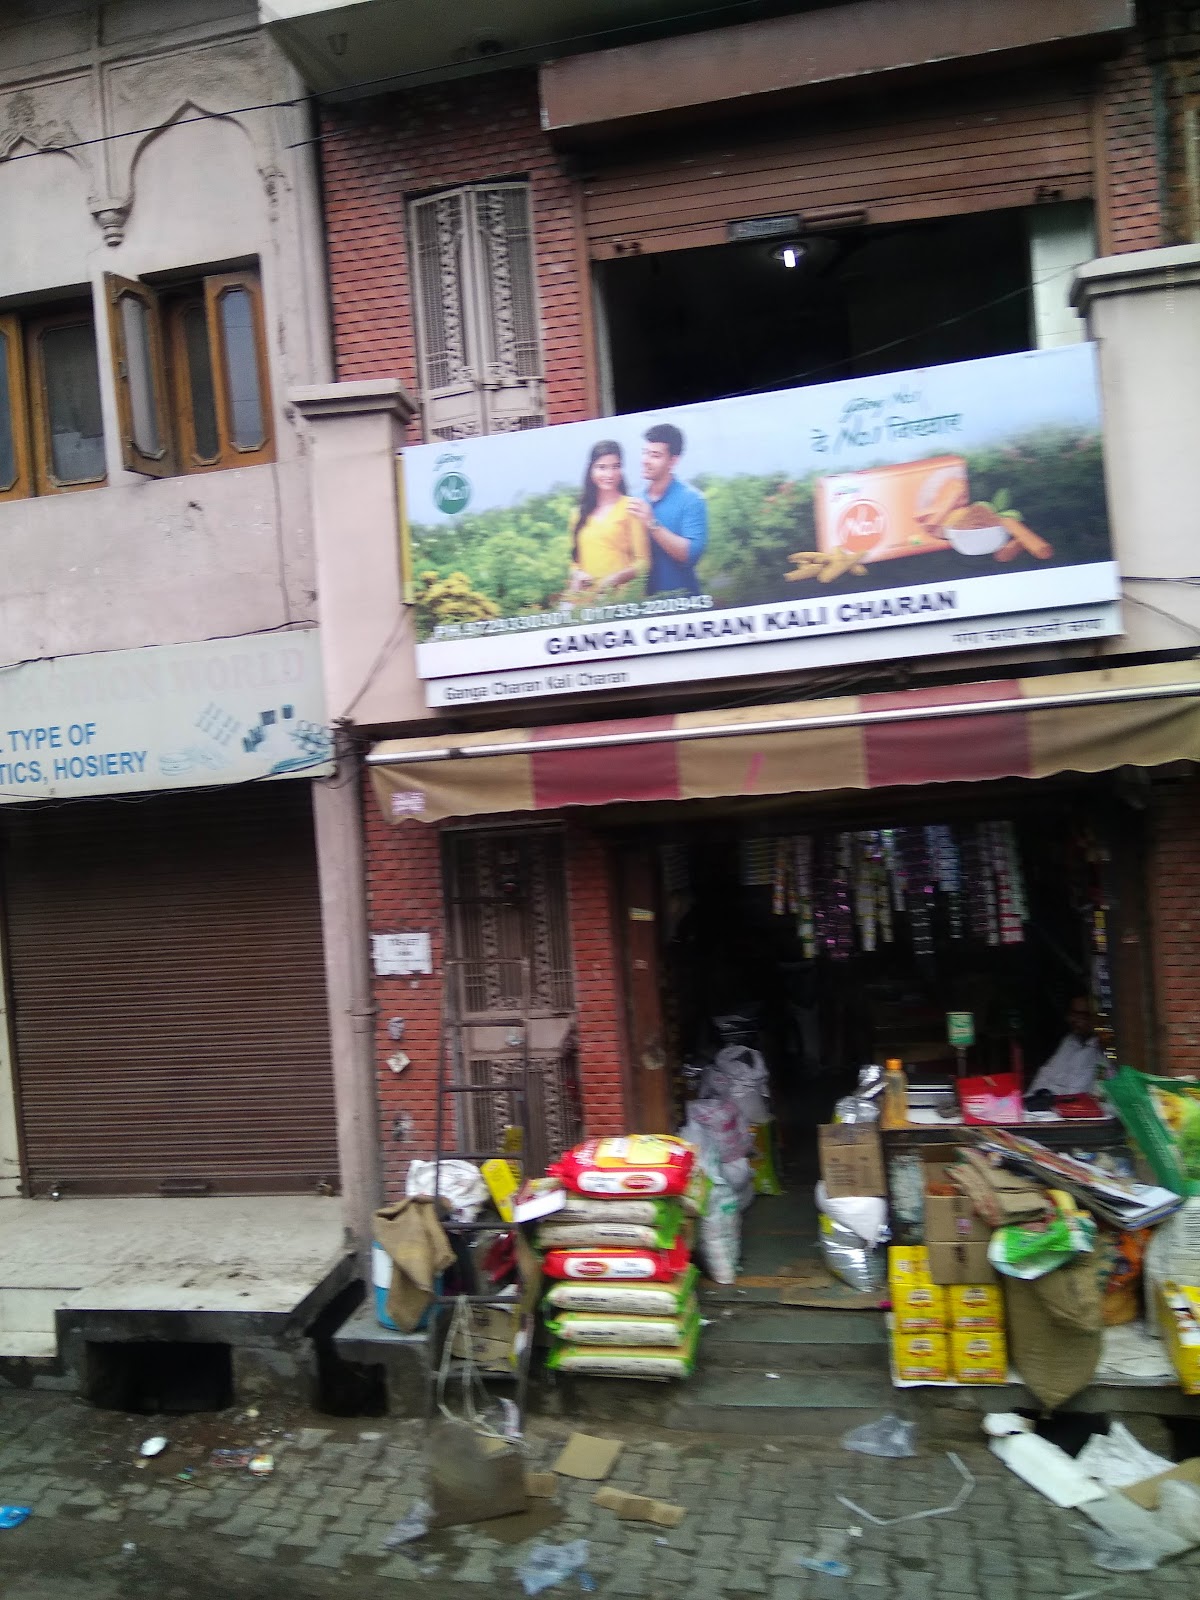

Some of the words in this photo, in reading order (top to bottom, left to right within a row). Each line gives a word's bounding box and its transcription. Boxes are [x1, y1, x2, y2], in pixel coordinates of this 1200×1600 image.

[545, 629, 637, 656] GANGA
[643, 615, 757, 645] CHARAN
[763, 606, 828, 632] KALI
[836, 590, 958, 623] CHARAN
[444, 685, 489, 701] Ganga
[491, 680, 543, 696] Charan
[545, 673, 575, 690] Kali
[576, 671, 630, 687] Charan
[7, 726, 62, 752] TYPE
[68, 722, 97, 747] OF
[54, 750, 148, 780] HOSIERY
